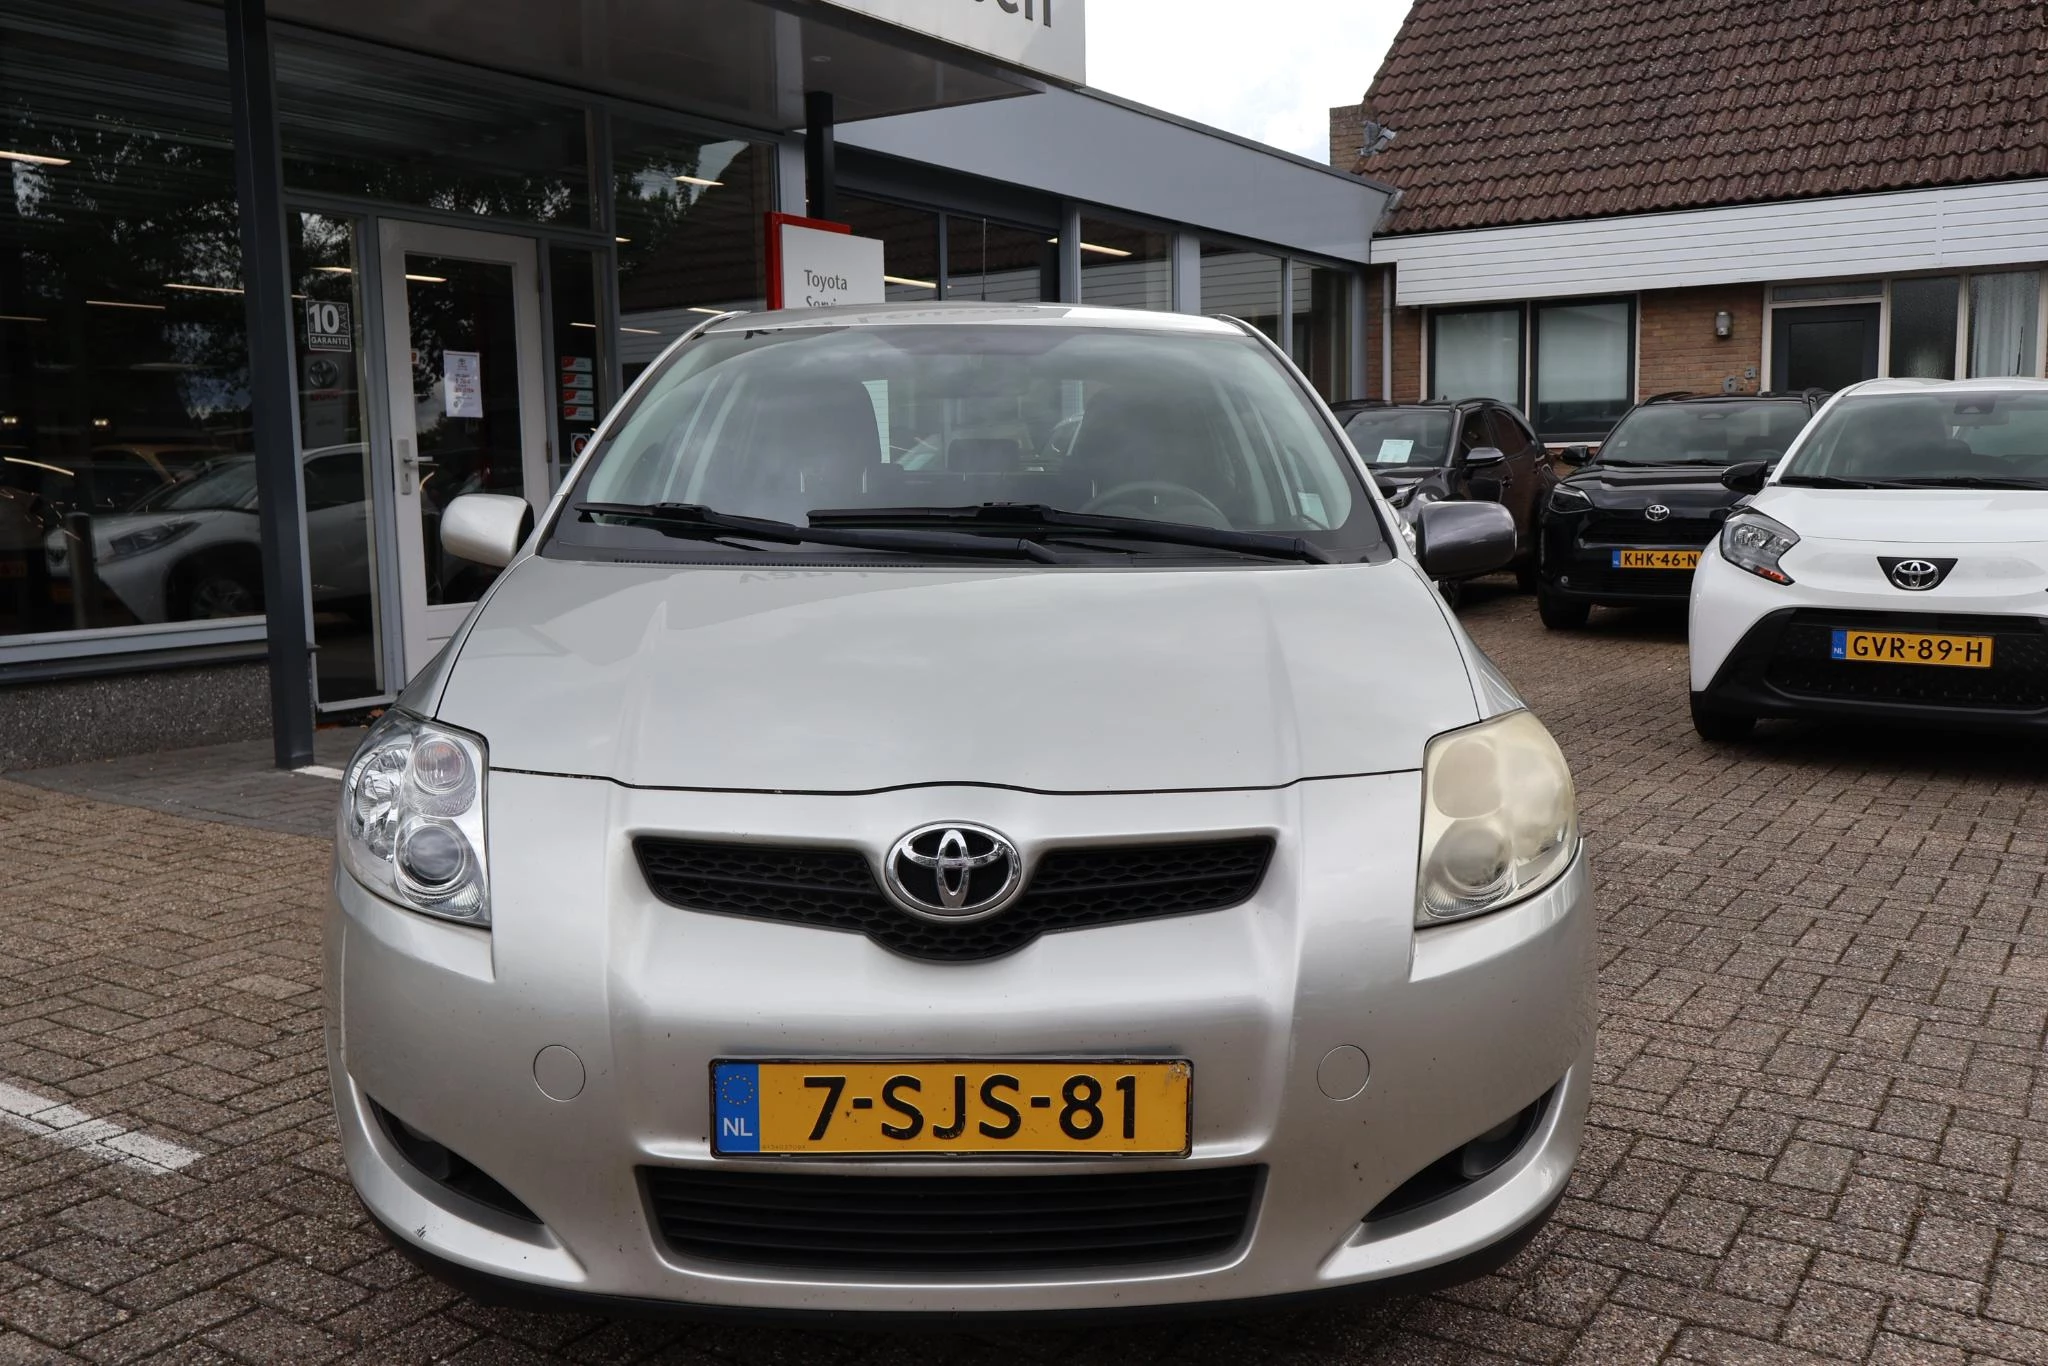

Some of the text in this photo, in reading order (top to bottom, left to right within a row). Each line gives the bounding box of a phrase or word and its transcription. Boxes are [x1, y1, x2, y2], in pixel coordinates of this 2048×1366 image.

[804, 269, 848, 293] Toyota
[309, 303, 340, 334] 10
[339, 304, 349, 334] JAAR
[311, 336, 349, 346] GARANTIE
[1624, 552, 1697, 567] KHK-46-N
[1833, 635, 1983, 663] NL GVR-89-H
[723, 1074, 1136, 1141] NL 7-SJS-81
